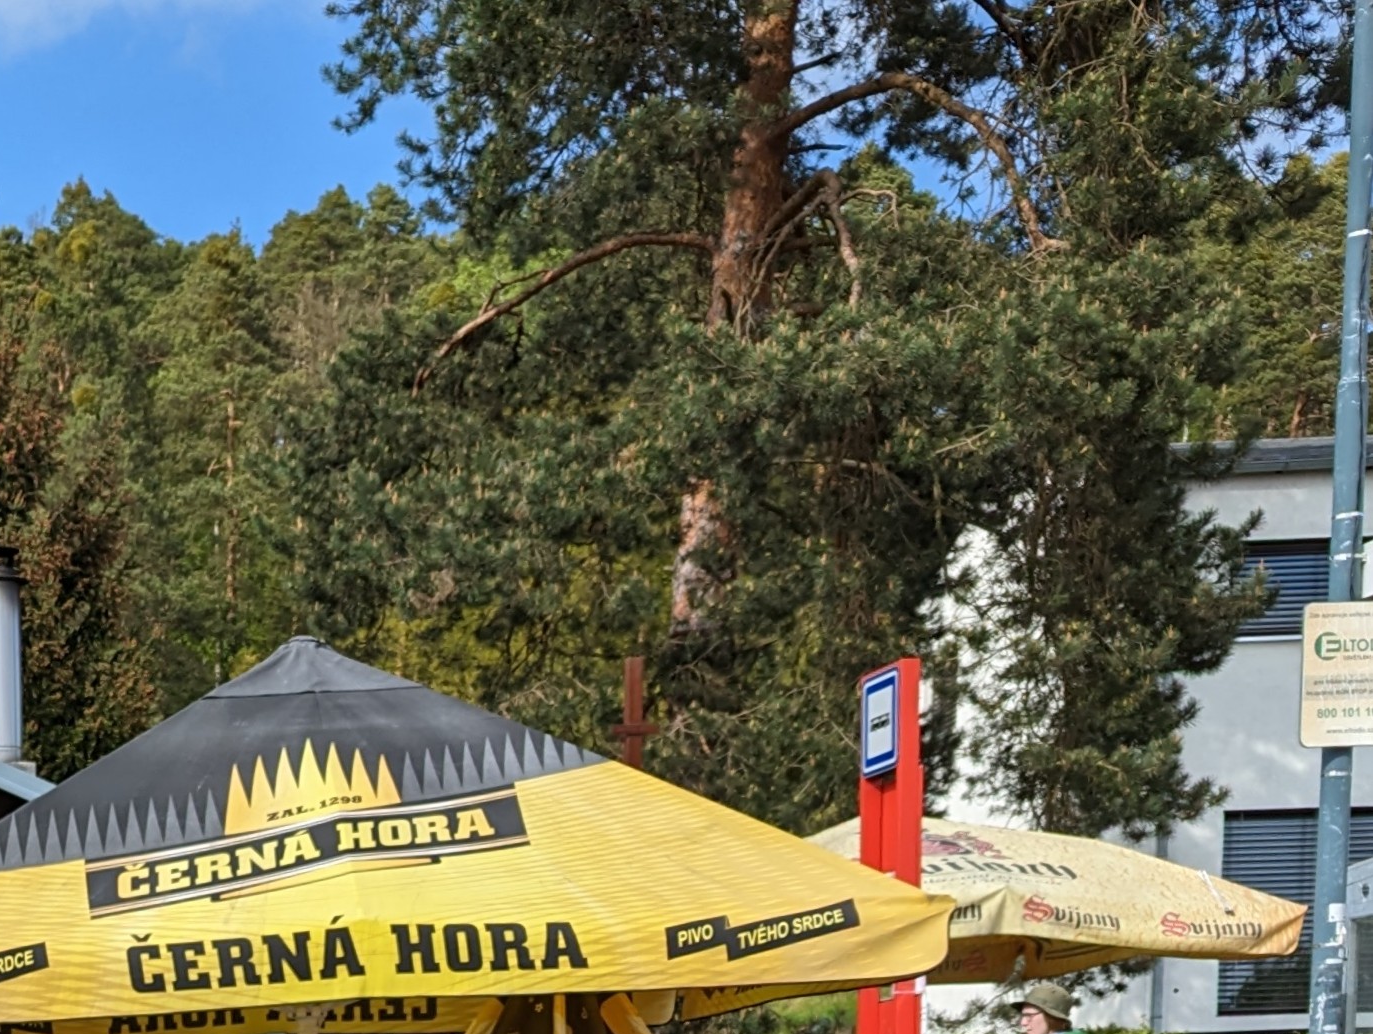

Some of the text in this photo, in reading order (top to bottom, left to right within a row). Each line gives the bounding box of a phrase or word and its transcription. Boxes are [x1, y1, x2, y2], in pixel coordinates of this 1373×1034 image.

[1314, 632, 1373, 661] ELTO
[1317, 708, 1338, 719] 800
[1341, 707, 1360, 718] 101
[266, 795, 364, 822] ZAL. 1298
[116, 808, 496, 900] ČERNÁ HORA
[677, 908, 845, 949] PIVO TVÉHO SRDCE
[126, 914, 589, 994] ČERNÁ HORA
